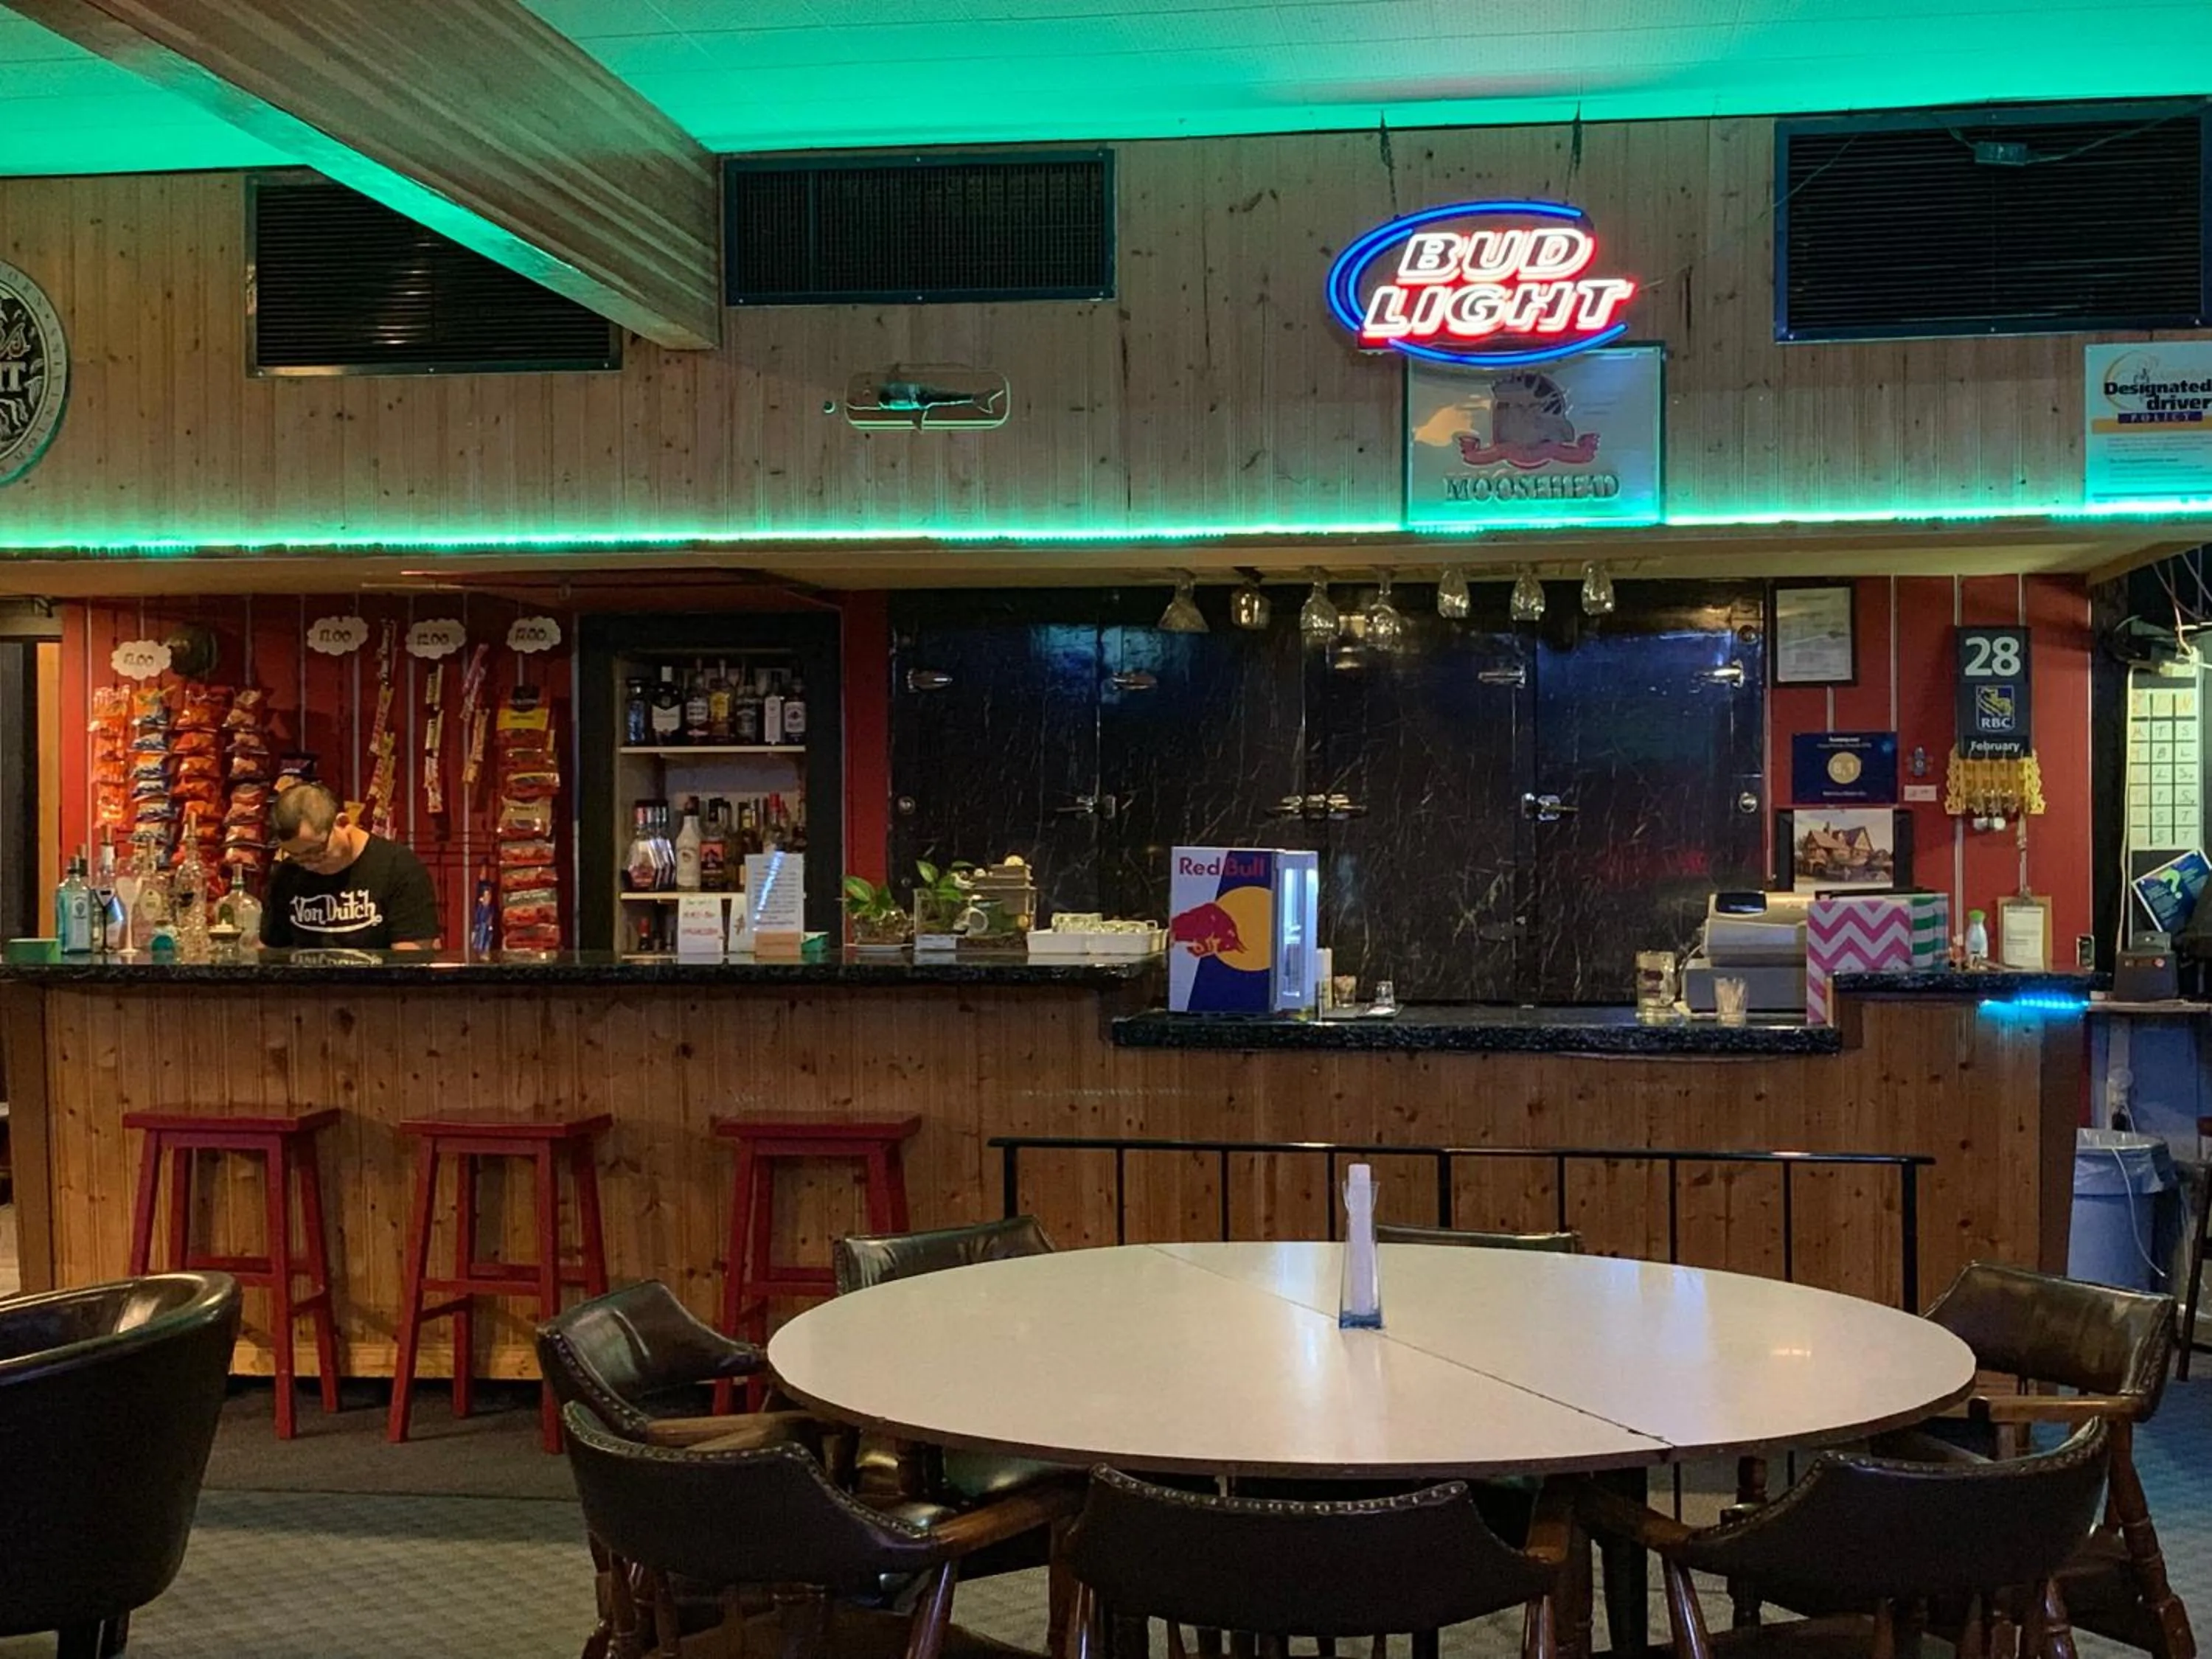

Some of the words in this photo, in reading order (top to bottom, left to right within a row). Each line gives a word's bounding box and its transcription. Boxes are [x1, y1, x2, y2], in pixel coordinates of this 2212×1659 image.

[1396, 227, 1593, 284] BUD
[1362, 278, 1635, 338] LIGHT
[2104, 378, 2212, 397] Designated
[2146, 394, 2212, 410] driver
[1446, 474, 1621, 501] MOOSEHEAD
[1964, 636, 2021, 676] 28
[1981, 717, 2011, 728] RBC
[1971, 741, 2020, 752] February
[1179, 857, 1220, 876] Red
[1225, 858, 1266, 877] Bull
[290, 895, 326, 925] Von
[325, 889, 377, 922] Dutch
